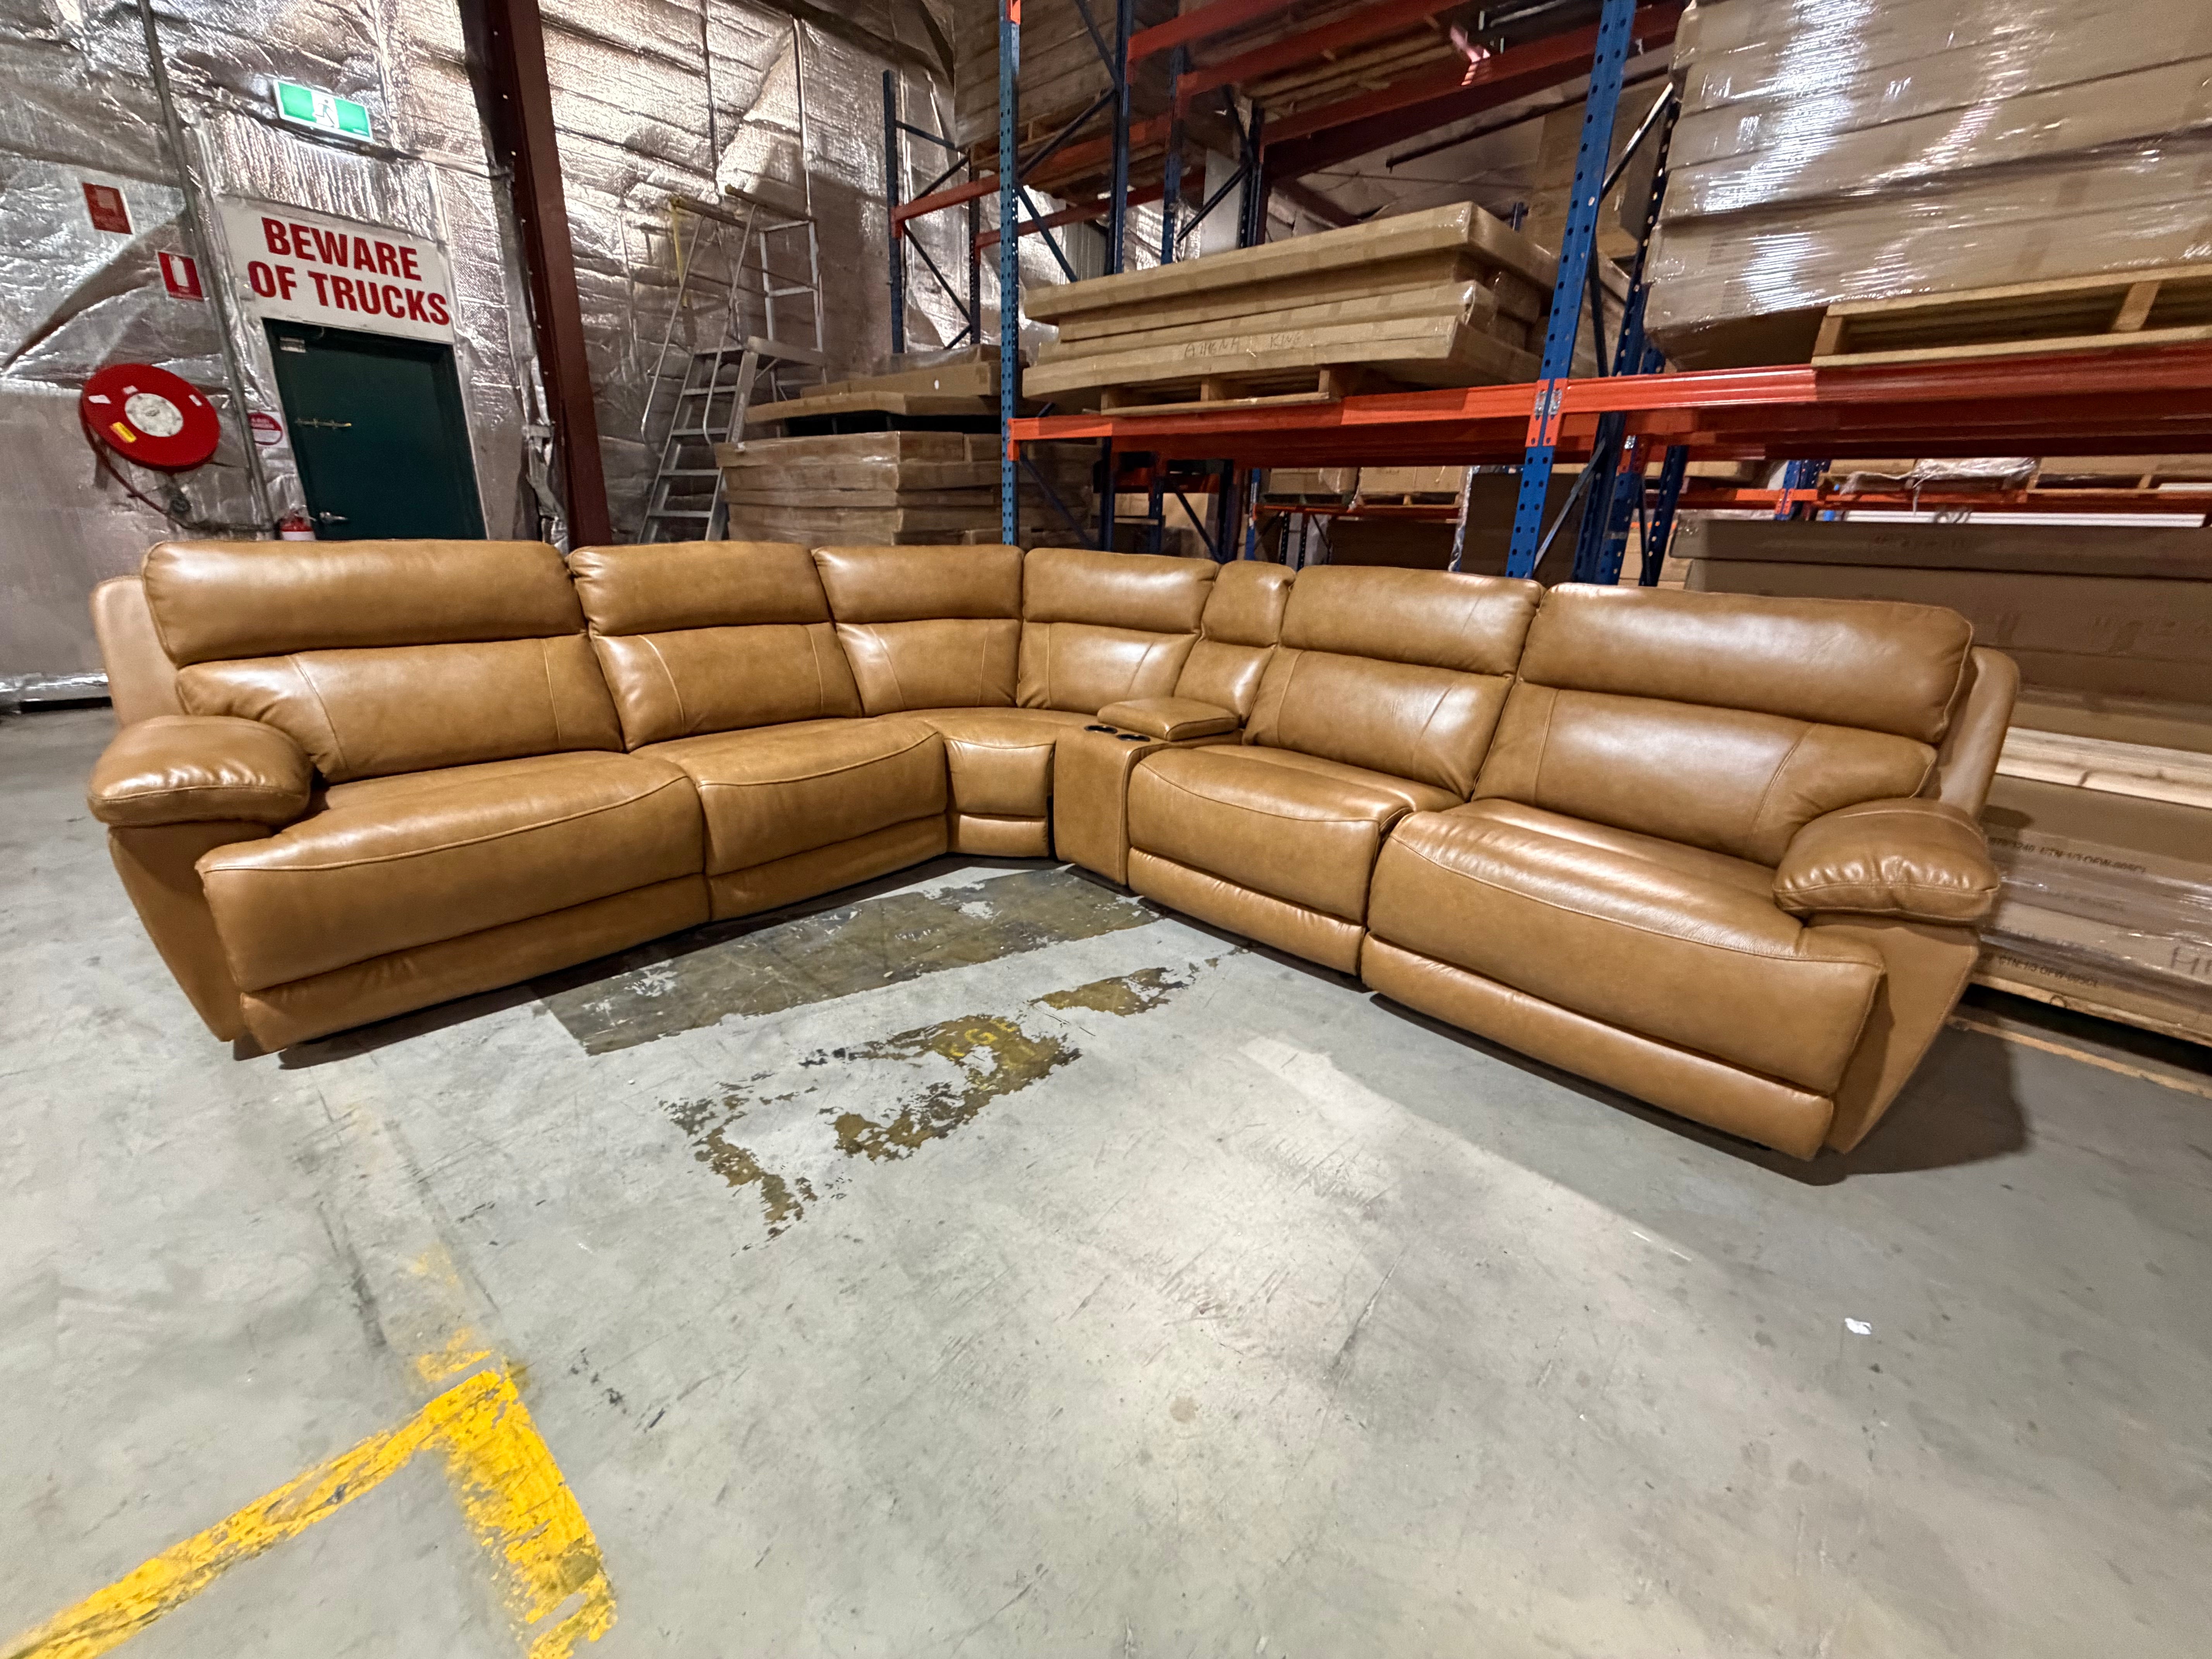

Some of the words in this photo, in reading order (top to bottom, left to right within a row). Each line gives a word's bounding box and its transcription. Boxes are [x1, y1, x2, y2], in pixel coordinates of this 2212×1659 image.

[261, 217, 422, 281] BEWARE
[247, 260, 297, 301] OF
[307, 270, 450, 326] TRUCKS
